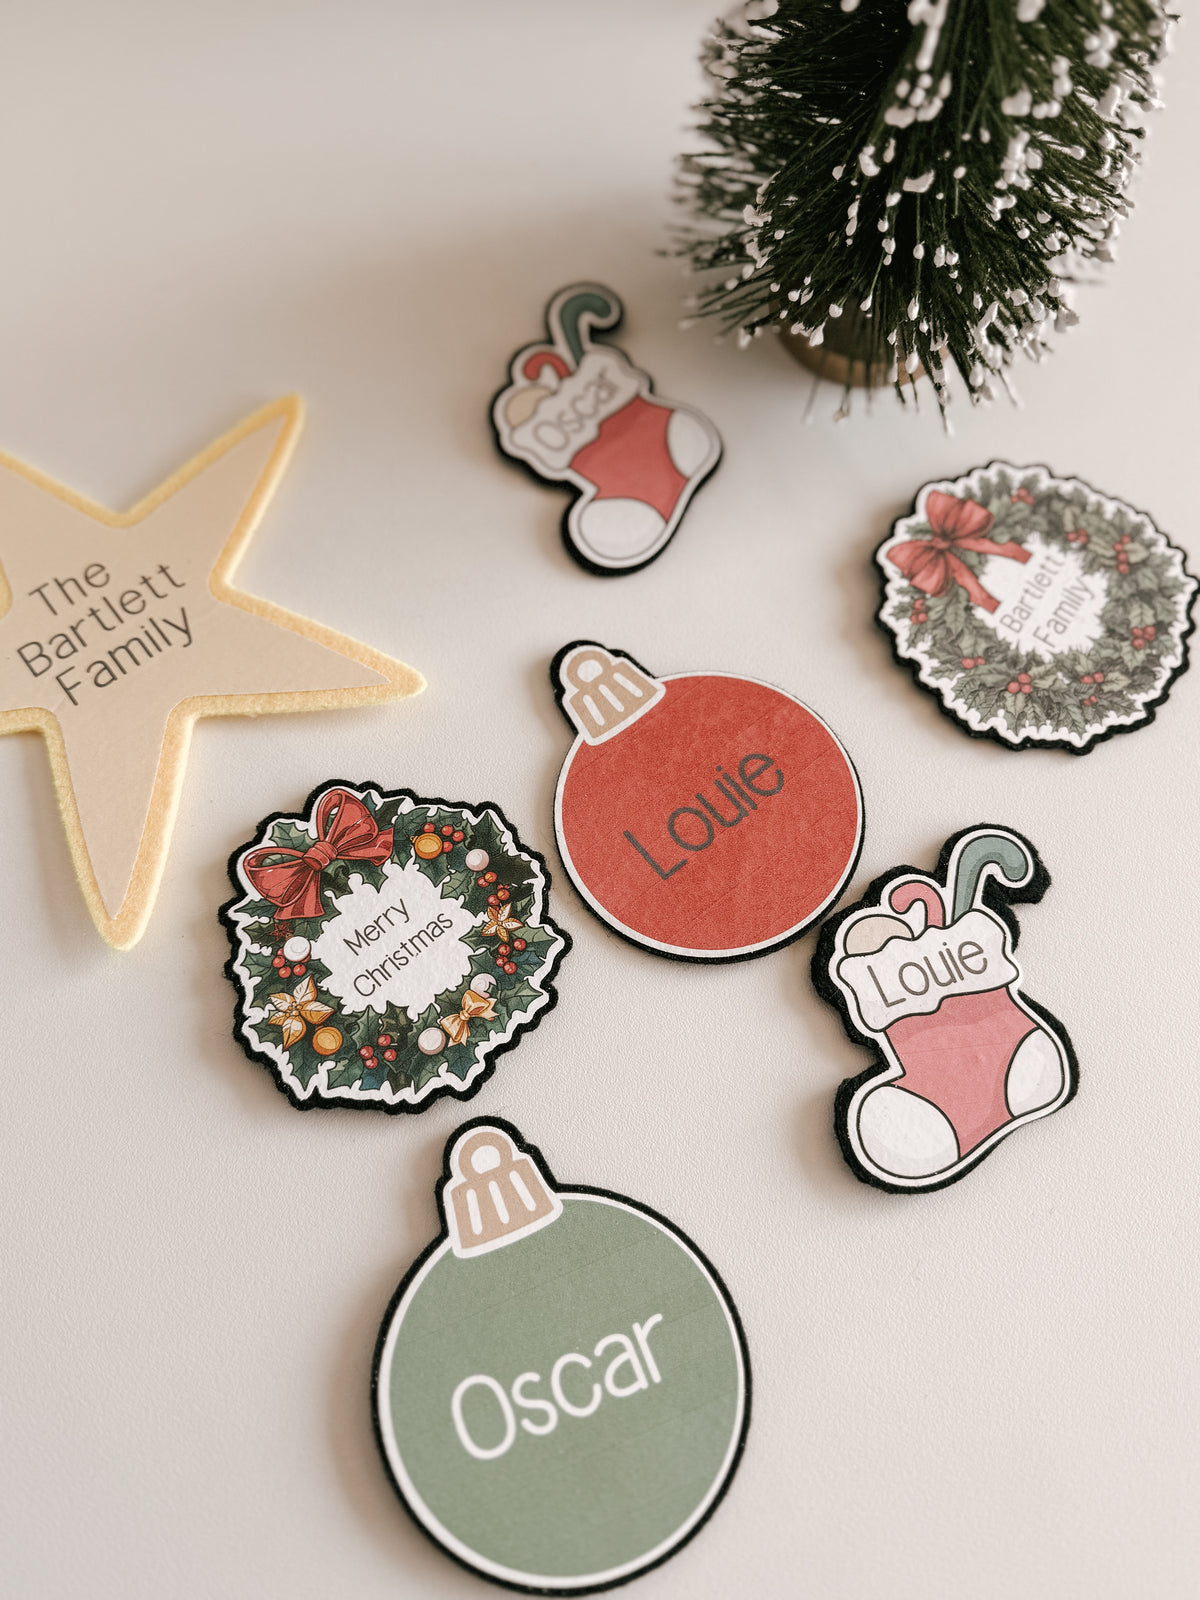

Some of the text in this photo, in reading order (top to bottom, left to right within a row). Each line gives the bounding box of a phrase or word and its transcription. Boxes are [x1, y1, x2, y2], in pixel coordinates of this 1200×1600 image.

[16, 564, 187, 678] Bartlett
[28, 563, 110, 616] The
[999, 555, 1065, 634] Bartlett
[1032, 576, 1095, 648] Family
[55, 606, 192, 706] Family
[623, 753, 785, 881] Louie
[342, 898, 410, 956] Merry
[353, 913, 453, 997] Christmas
[866, 941, 988, 1008] Louie
[451, 1313, 663, 1459] Oscar
